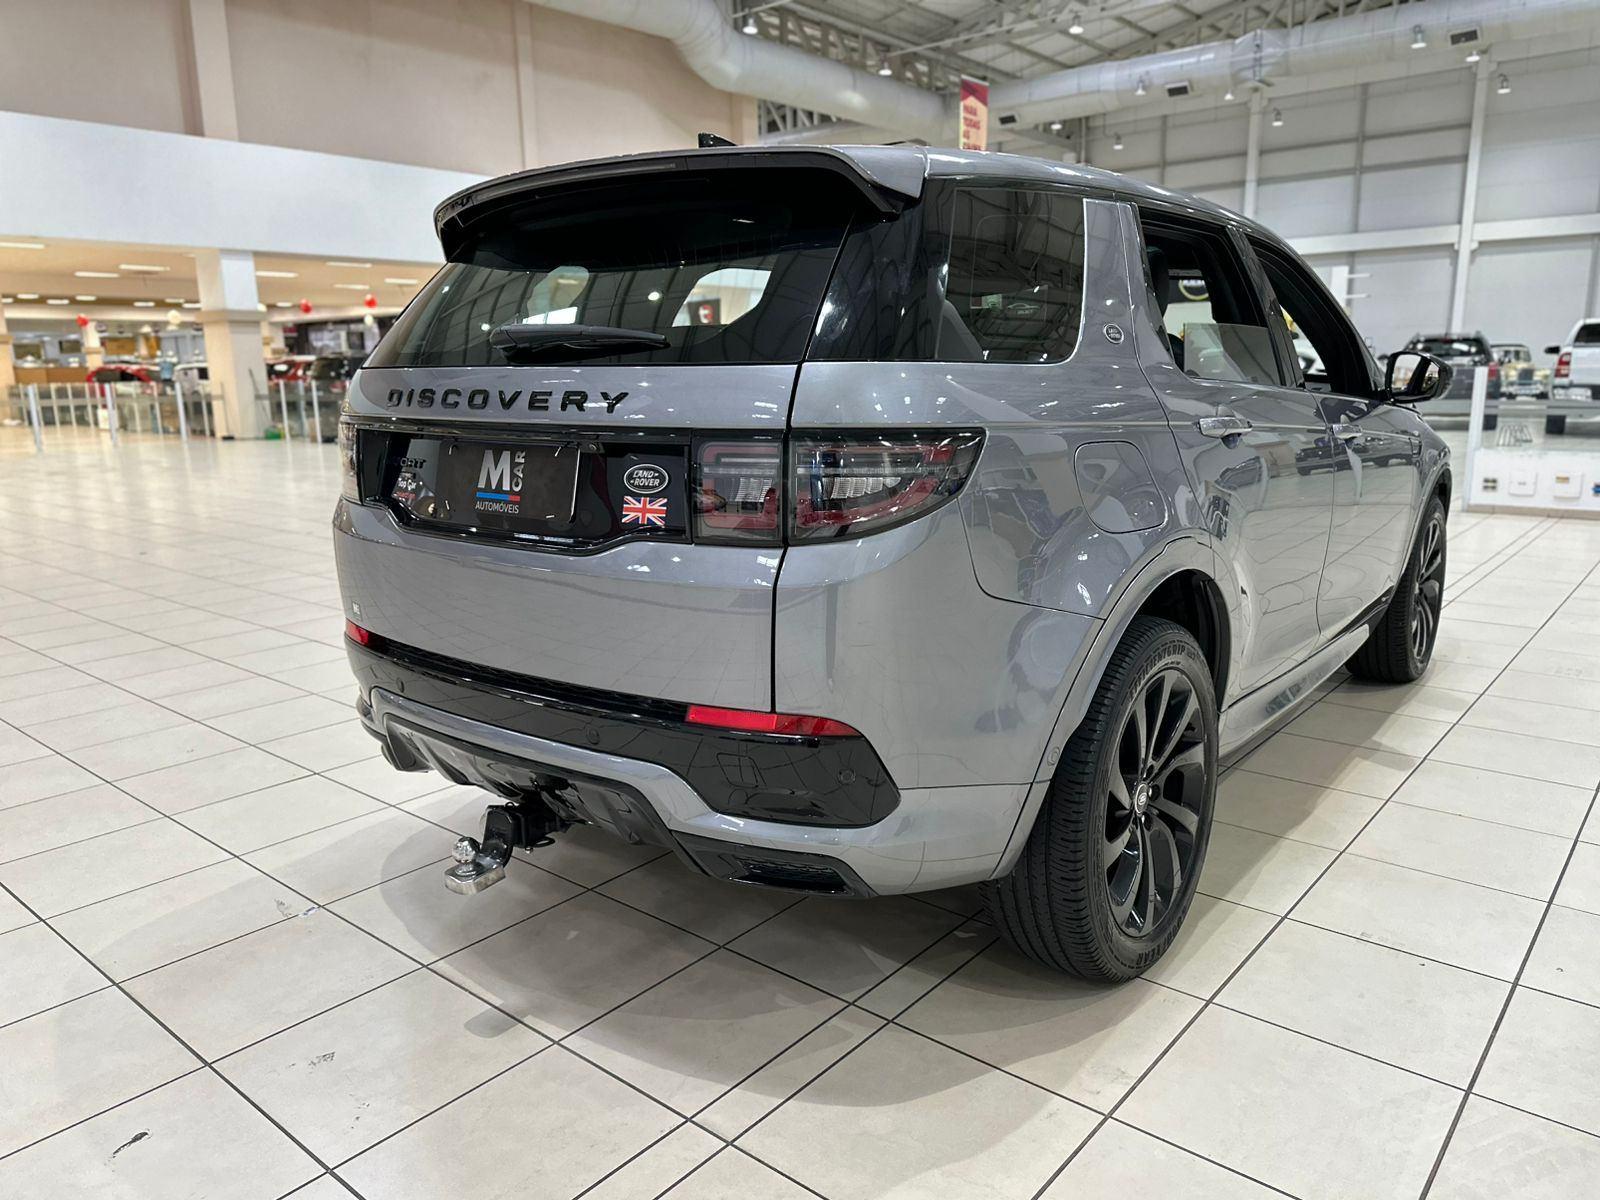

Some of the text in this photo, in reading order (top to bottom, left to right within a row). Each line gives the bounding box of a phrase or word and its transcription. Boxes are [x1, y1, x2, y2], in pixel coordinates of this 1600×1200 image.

[387, 388, 629, 414] DISCOVERY
[477, 449, 510, 490] M
[512, 450, 526, 492] CAR
[633, 470, 655, 478] LAND
[634, 478, 661, 487] ROVER
[475, 500, 520, 514] AUTOMÓVEIS
